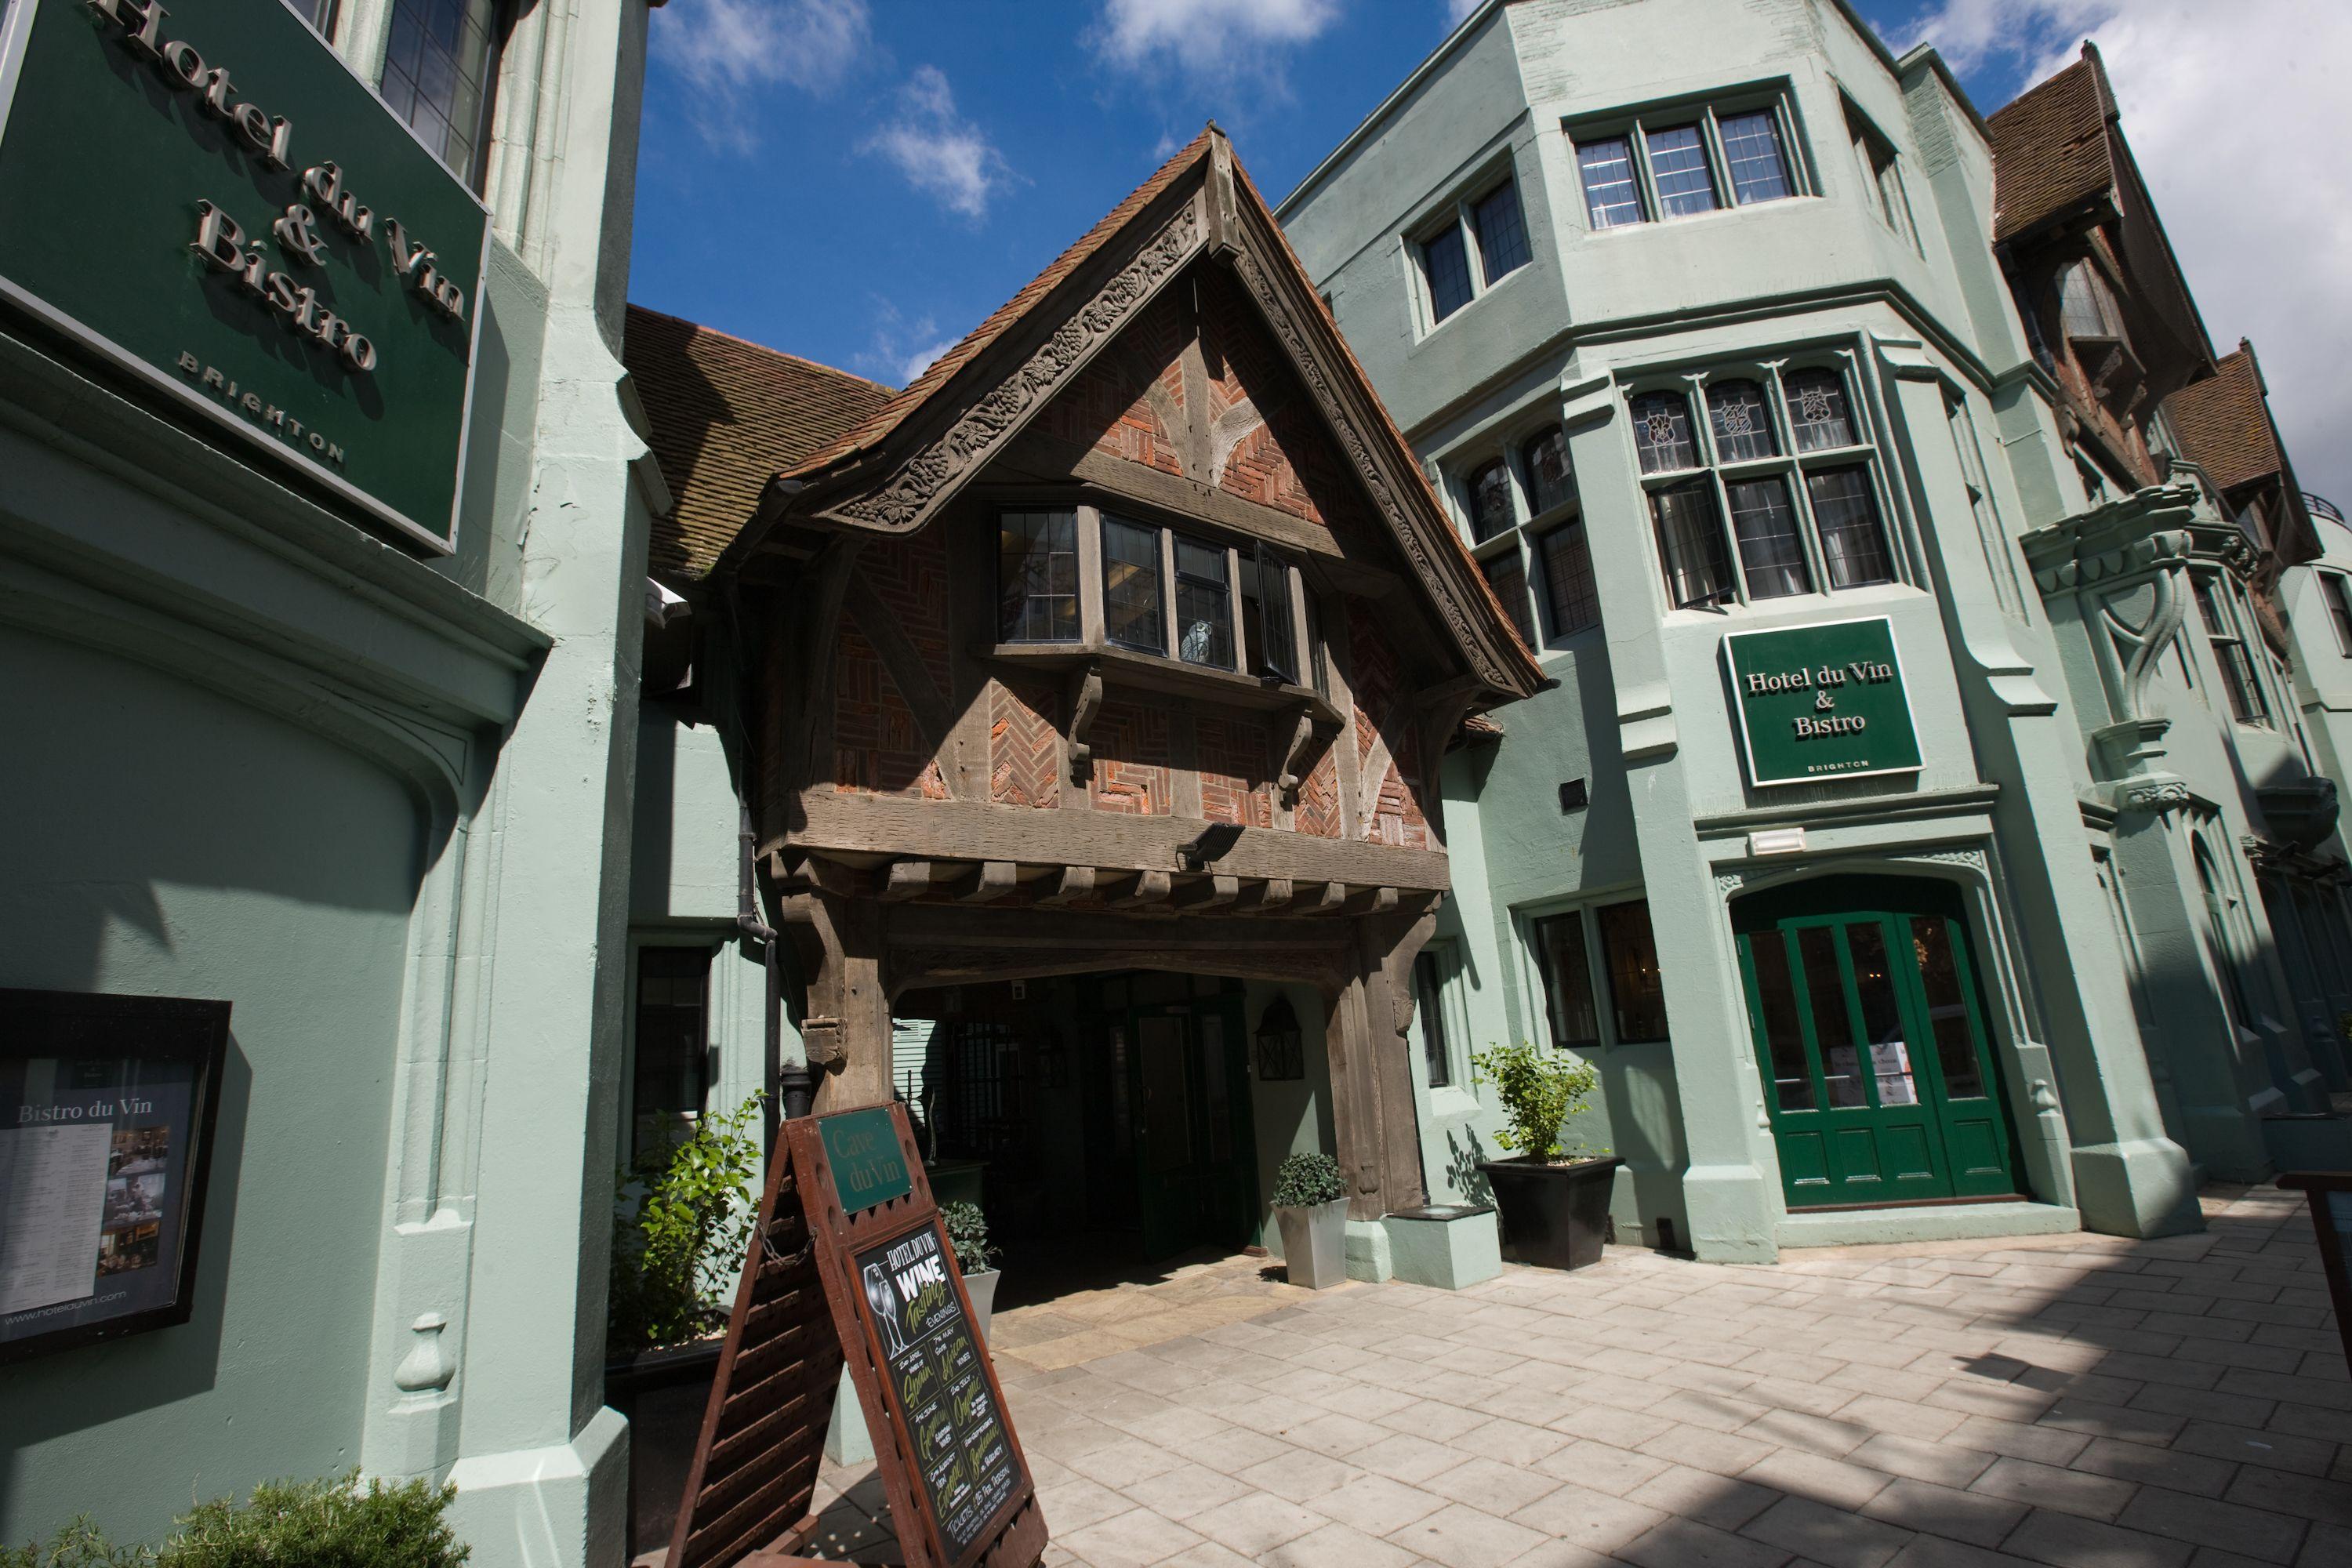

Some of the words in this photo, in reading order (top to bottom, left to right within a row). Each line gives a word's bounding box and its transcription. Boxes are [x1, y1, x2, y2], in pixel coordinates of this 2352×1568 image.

[87, 0, 292, 170] Hotel
[303, 161, 374, 244] du
[385, 217, 465, 321] Vin
[274, 204, 328, 267] &
[190, 198, 377, 371] Bistro
[178, 350, 345, 463] BRIGHTON
[1747, 668, 1812, 692] Hotel
[1817, 666, 1847, 684] du
[1848, 661, 1893, 681] Vin
[1816, 690, 1835, 710] &
[1793, 715, 1866, 736] Bistro
[1807, 760, 1870, 773] BRIGHTON
[17, 1104, 83, 1123] Bistro
[88, 1100, 114, 1118] du
[119, 1098, 153, 1115] Vin
[833, 1129, 877, 1158] Cave
[887, 1242, 916, 1272] HOTEL
[895, 1254, 946, 1302] WINE
[906, 1279, 947, 1334] Tasting
[925, 1301, 956, 1327] EVENINGS
[942, 1327, 954, 1339] MAY
[904, 1366, 934, 1408] Spain
[954, 1376, 982, 1427] Organic
[937, 1460, 964, 1519] Europe
[991, 1465, 1010, 1487] PERSON
